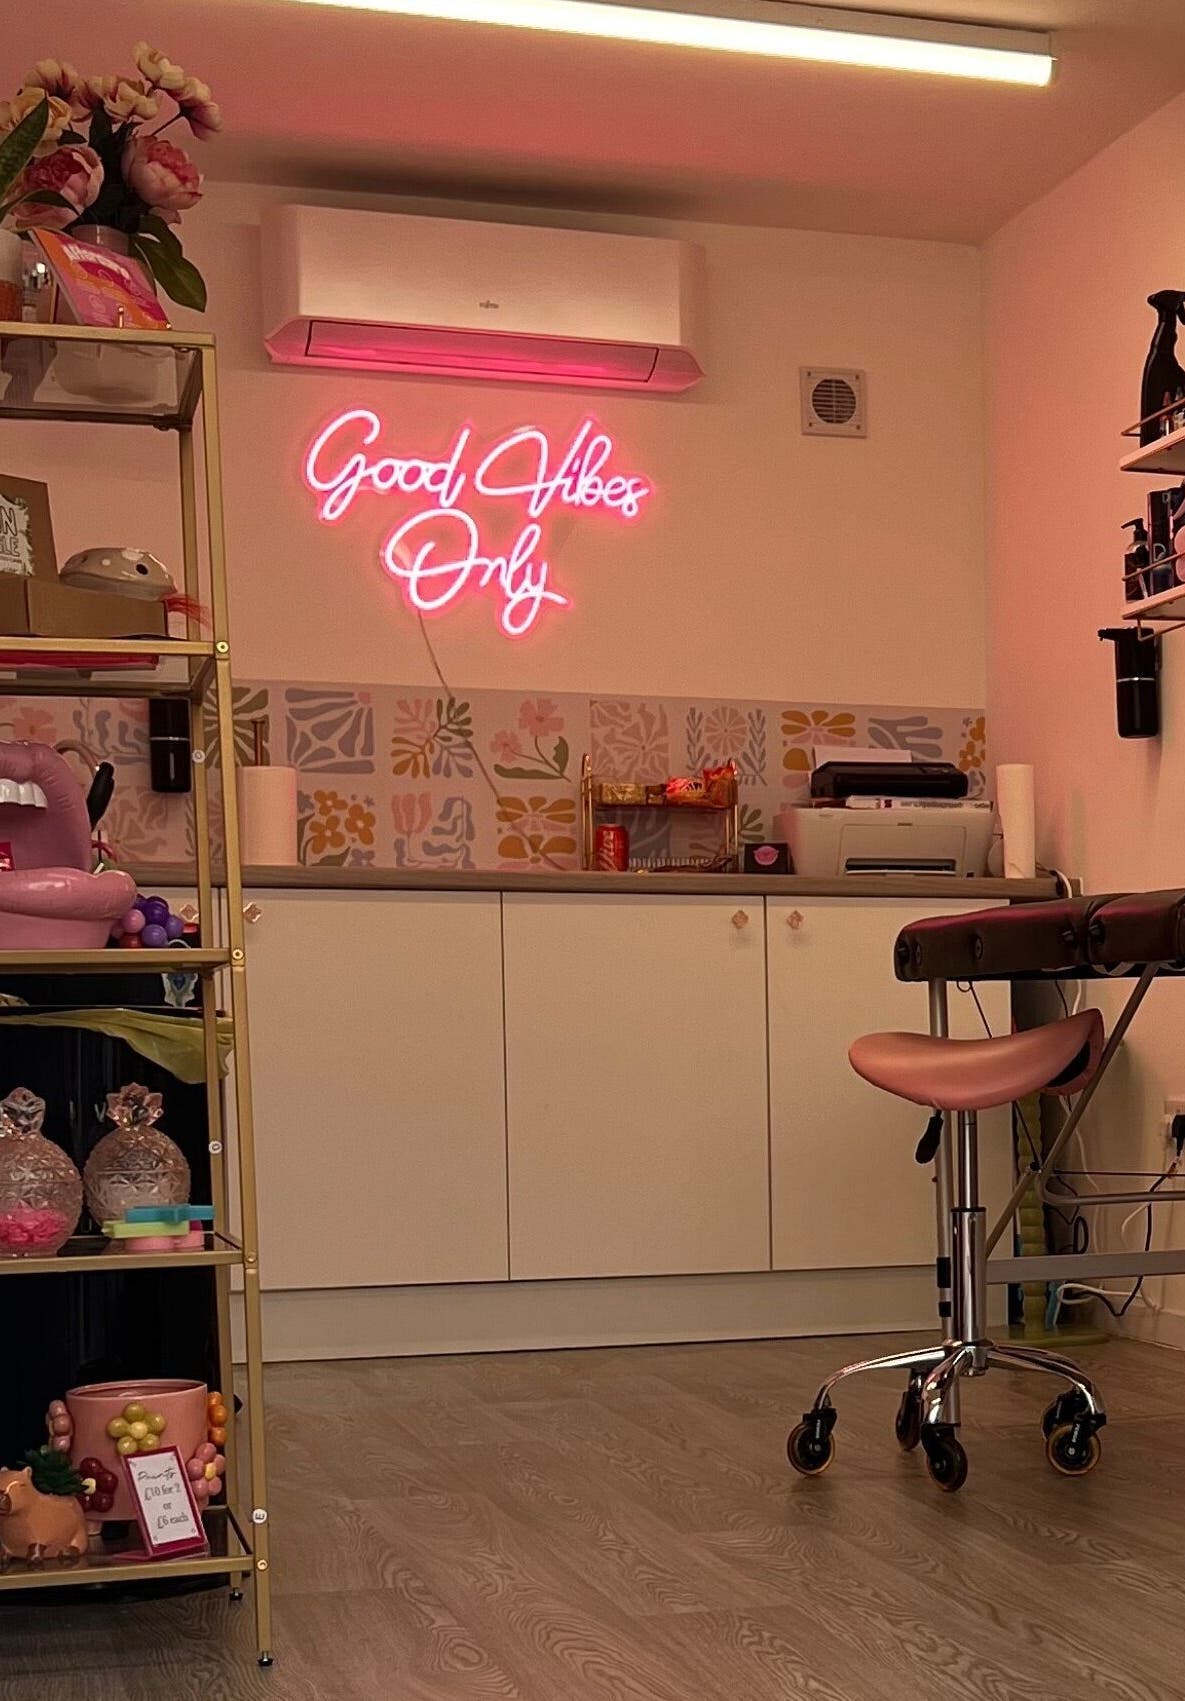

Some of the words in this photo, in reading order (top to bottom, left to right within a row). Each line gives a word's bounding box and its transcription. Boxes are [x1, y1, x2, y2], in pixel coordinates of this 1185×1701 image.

[306, 408, 472, 521] Good
[473, 418, 650, 518] Vibes
[384, 507, 568, 634] Only
